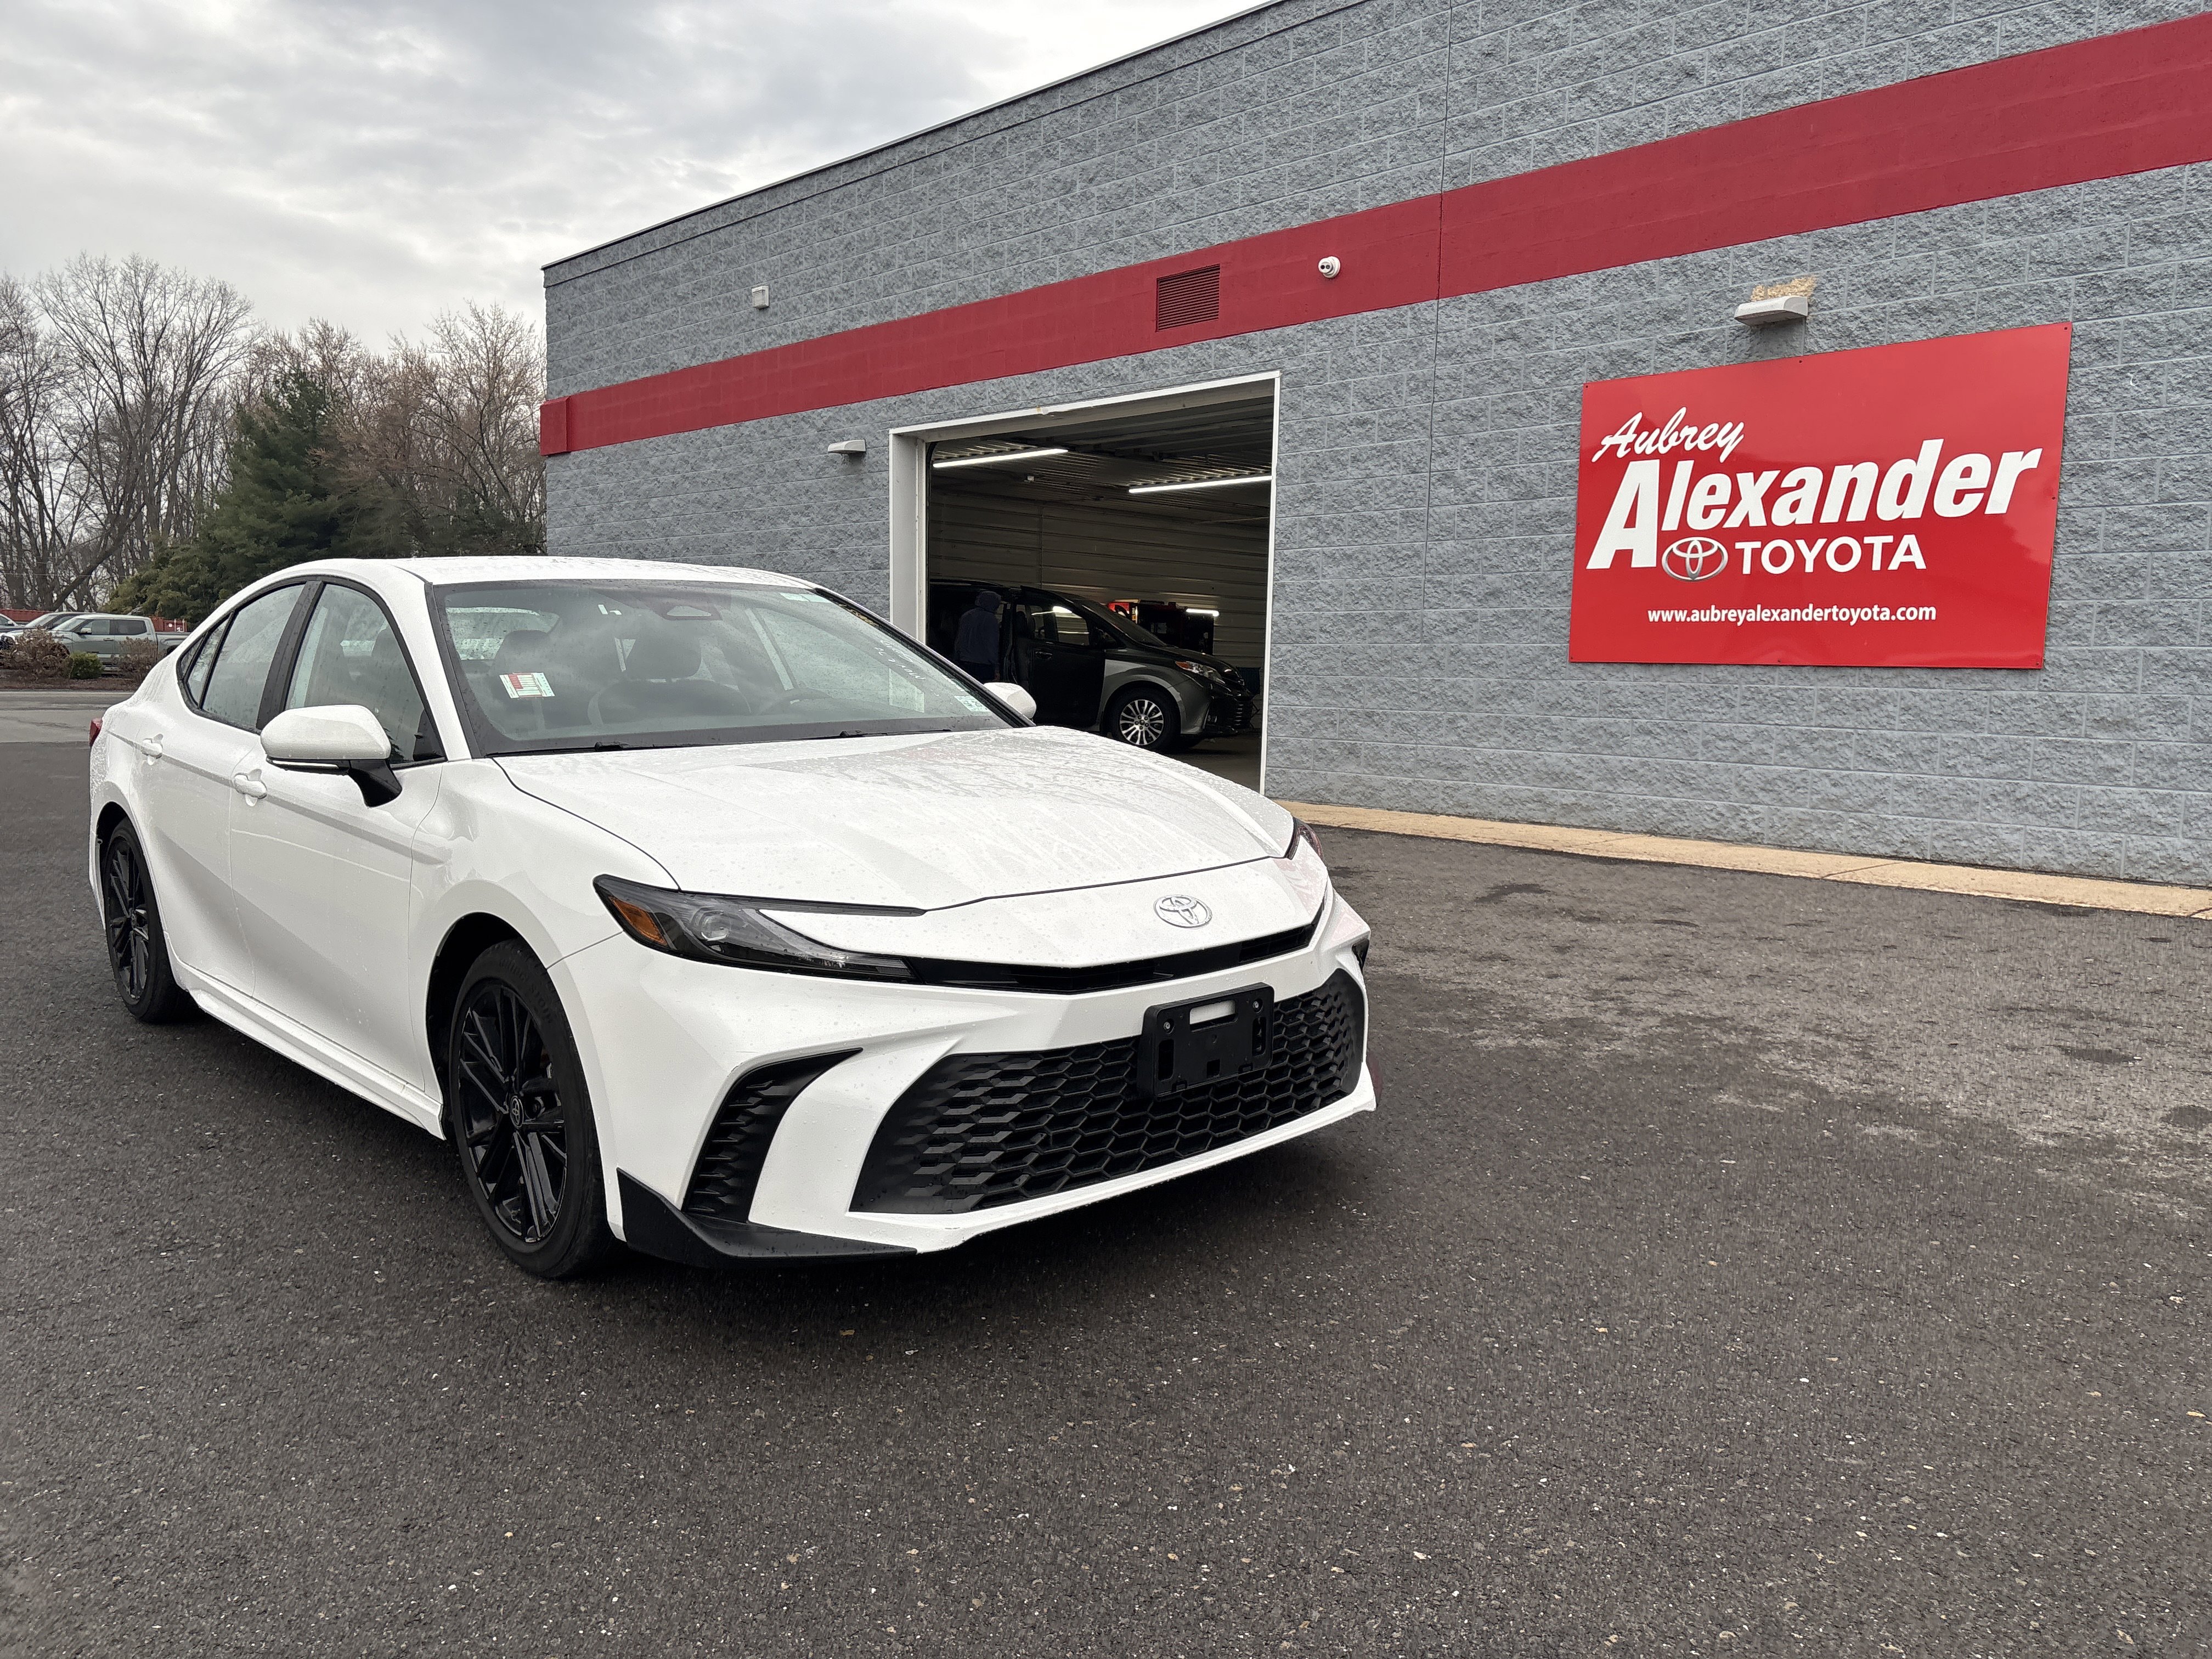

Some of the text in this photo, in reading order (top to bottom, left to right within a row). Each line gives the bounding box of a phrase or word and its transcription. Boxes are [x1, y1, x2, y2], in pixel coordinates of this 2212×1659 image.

[1592, 407, 1744, 463] Aubrey
[1587, 438, 2043, 569] Alexander
[1735, 534, 1927, 574] TOYOTA
[1647, 603, 1937, 627] www.aubreyalexandertoyota.com
